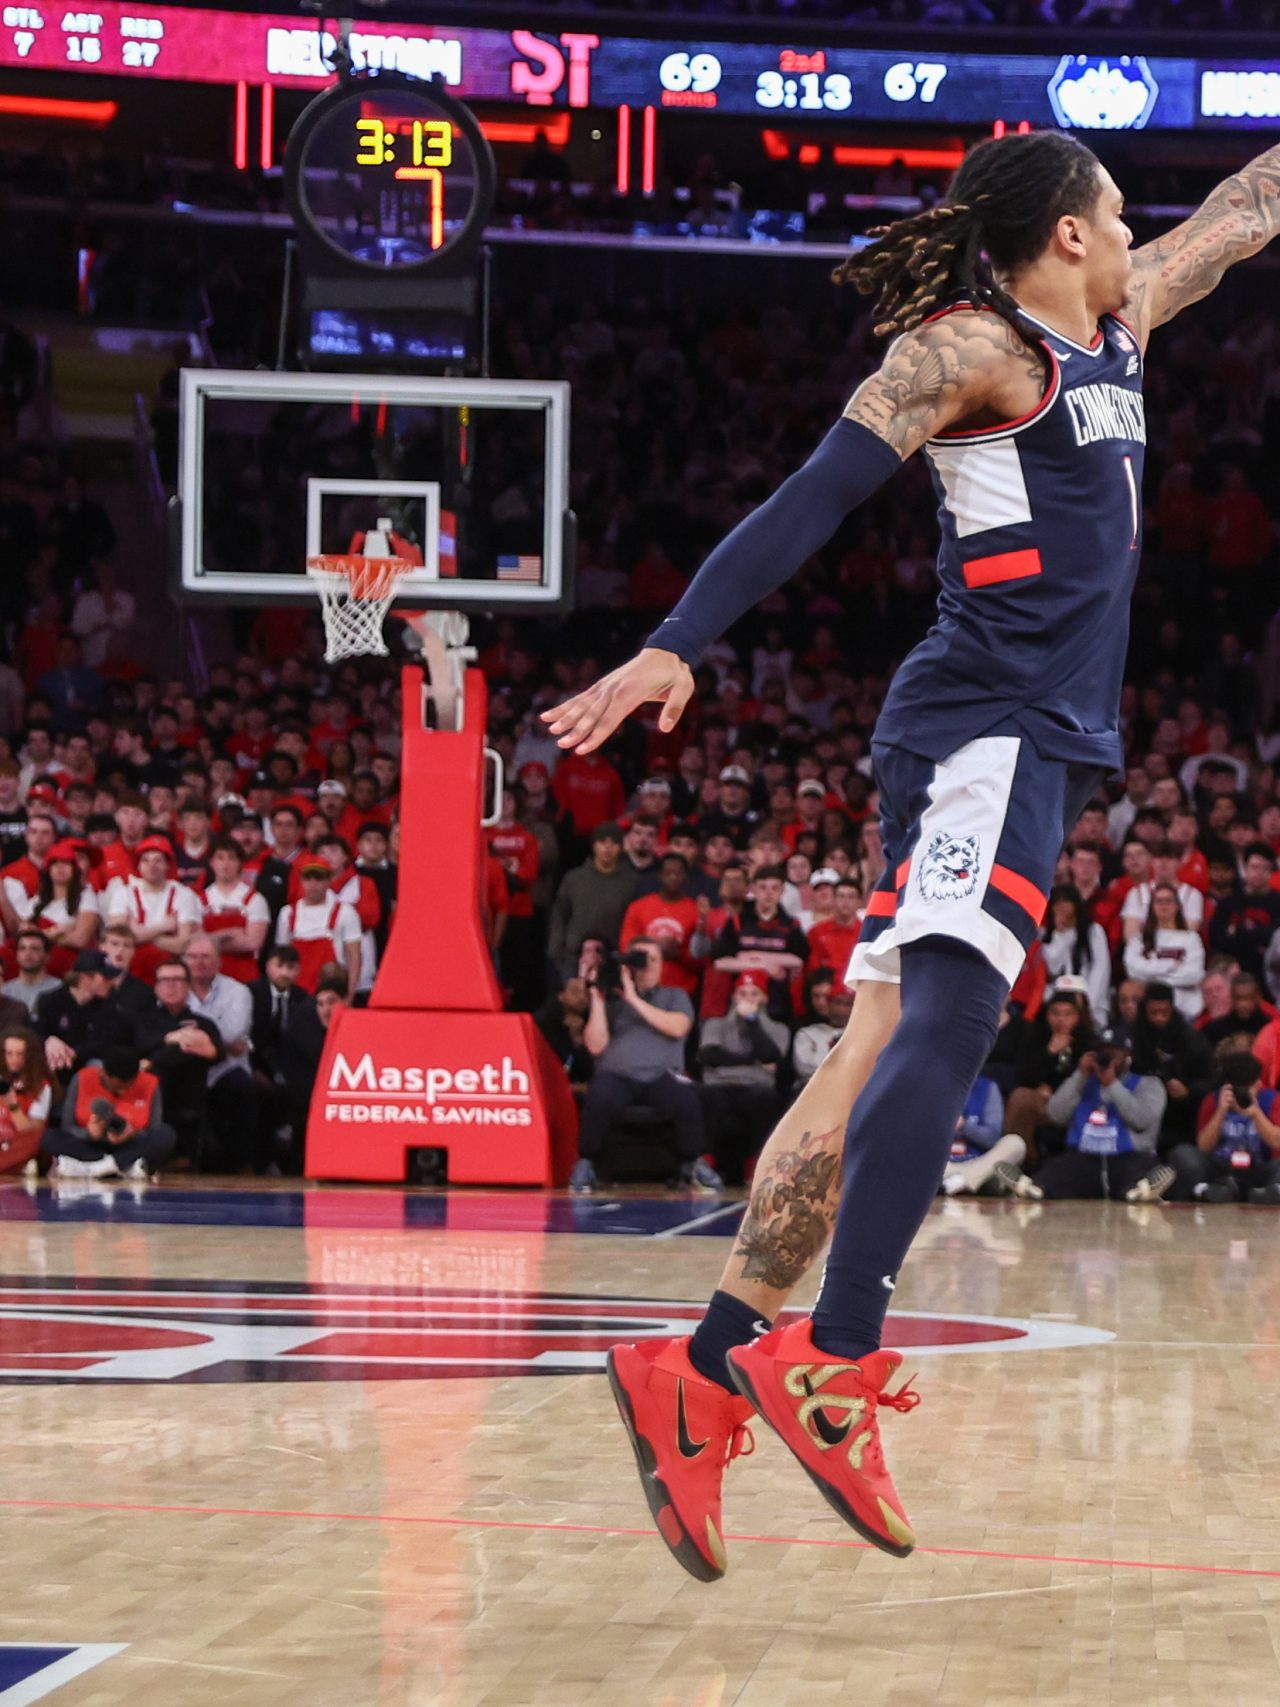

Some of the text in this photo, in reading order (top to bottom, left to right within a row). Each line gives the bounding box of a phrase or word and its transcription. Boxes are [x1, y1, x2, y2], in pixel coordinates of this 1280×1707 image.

[14, 31, 35, 57] 7
[122, 41, 160, 67] 27
[660, 53, 721, 92] 69
[756, 71, 852, 110] 3:13
[884, 62, 947, 102] 67
[356, 119, 452, 167] 3:13
[395, 167, 443, 250] 7
[1123, 455, 1138, 550] 1
[328, 1052, 530, 1105] Maspeth
[325, 1104, 532, 1127] FEDERAL SAVINGS
